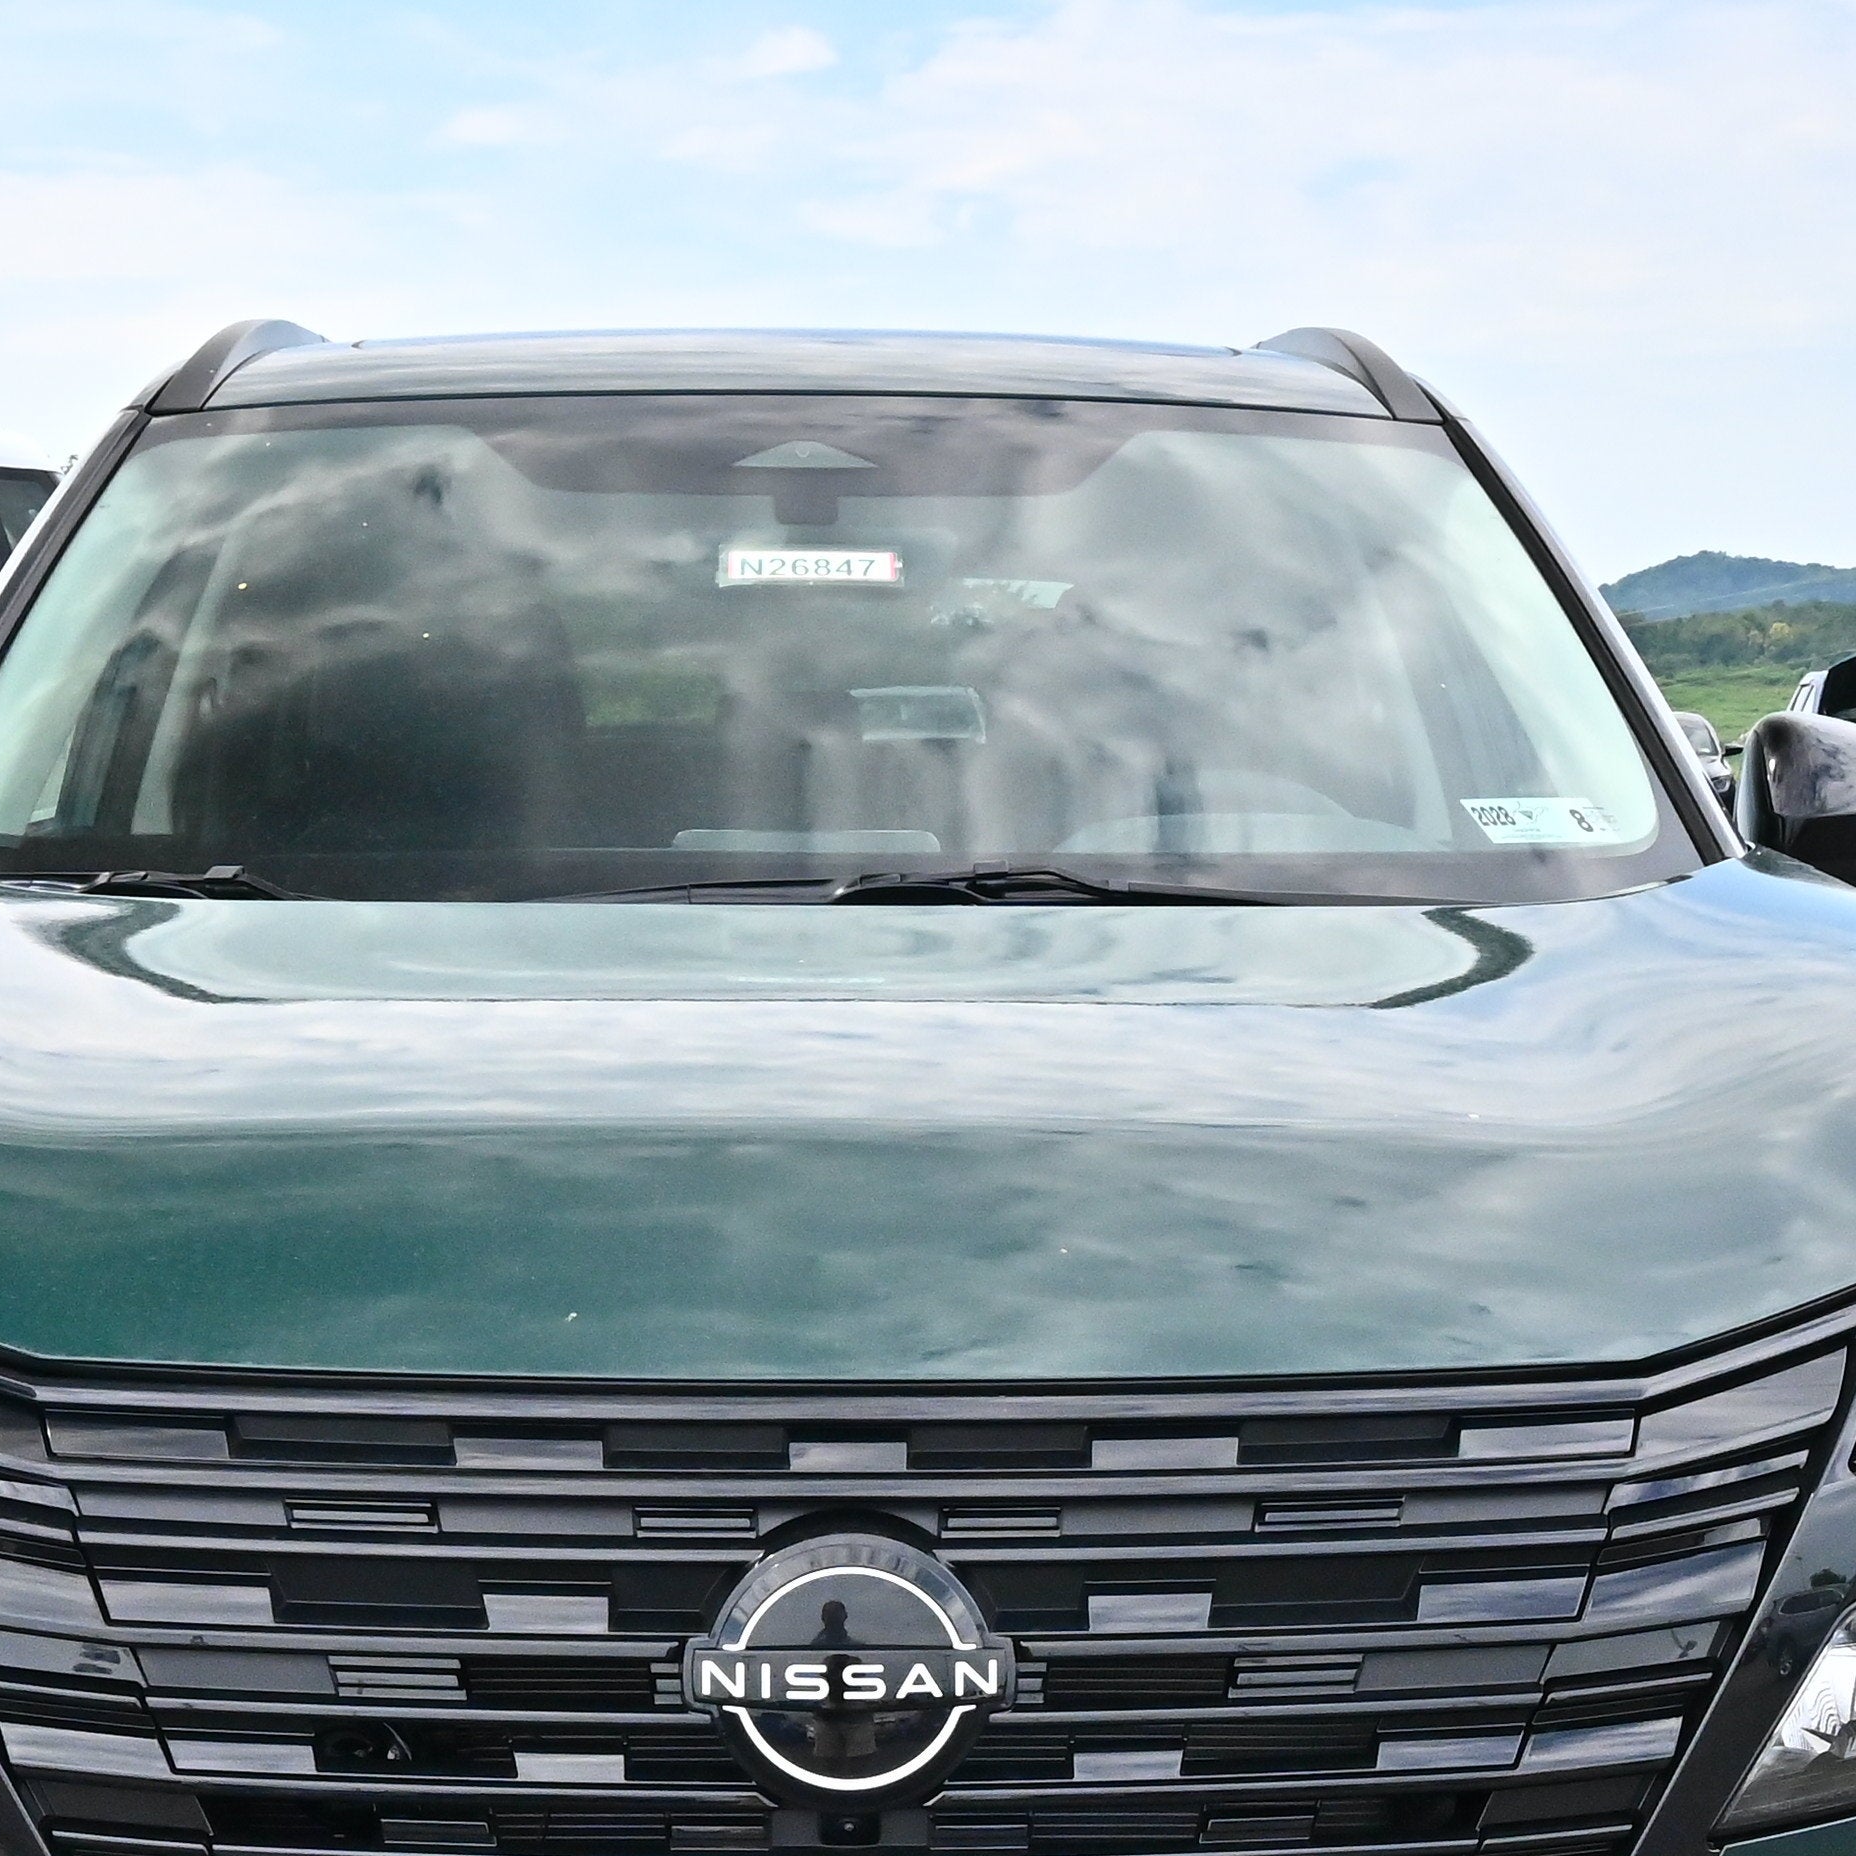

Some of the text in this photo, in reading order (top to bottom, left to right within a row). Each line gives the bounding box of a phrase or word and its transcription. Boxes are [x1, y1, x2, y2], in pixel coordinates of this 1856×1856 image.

[740, 558, 876, 577] N26847
[1470, 805, 1594, 833] 2028 8
[700, 1658, 998, 1701] NISSAN
